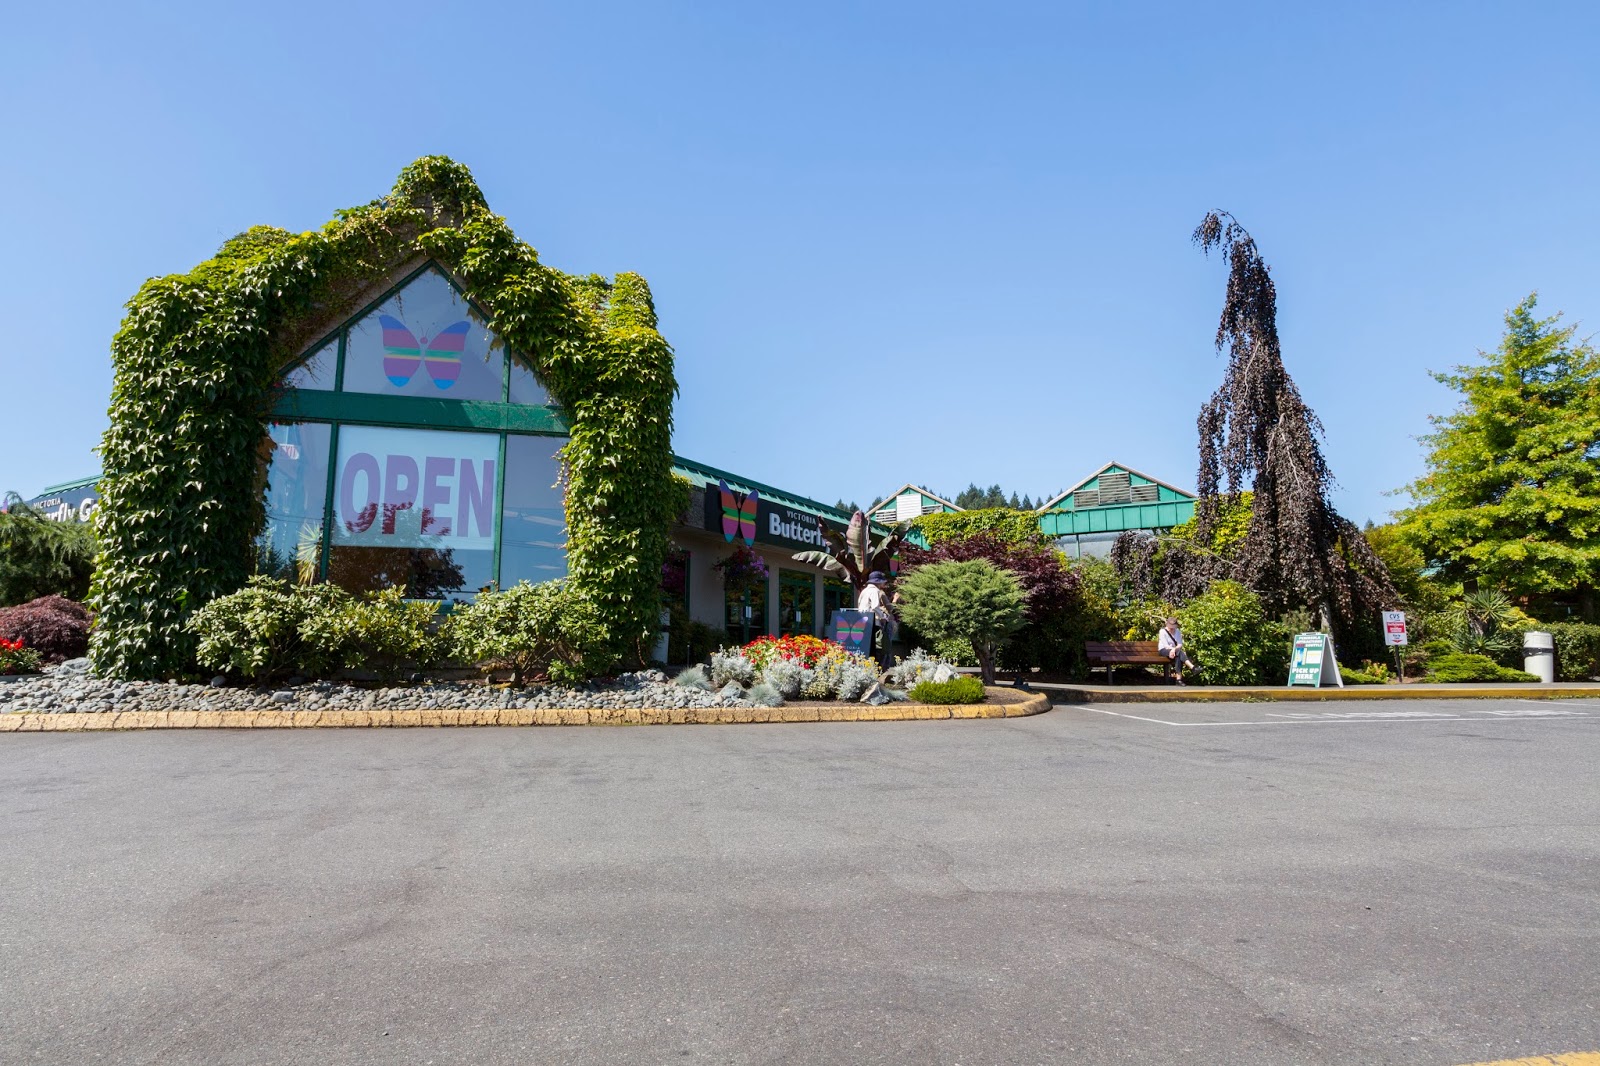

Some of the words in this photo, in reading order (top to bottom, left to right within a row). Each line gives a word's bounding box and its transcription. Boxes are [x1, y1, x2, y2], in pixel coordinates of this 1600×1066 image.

[33, 498, 61, 509] VICTORIA
[340, 452, 495, 538] OPEN
[786, 510, 817, 526] VICTORIA
[768, 512, 831, 554] Butterf
